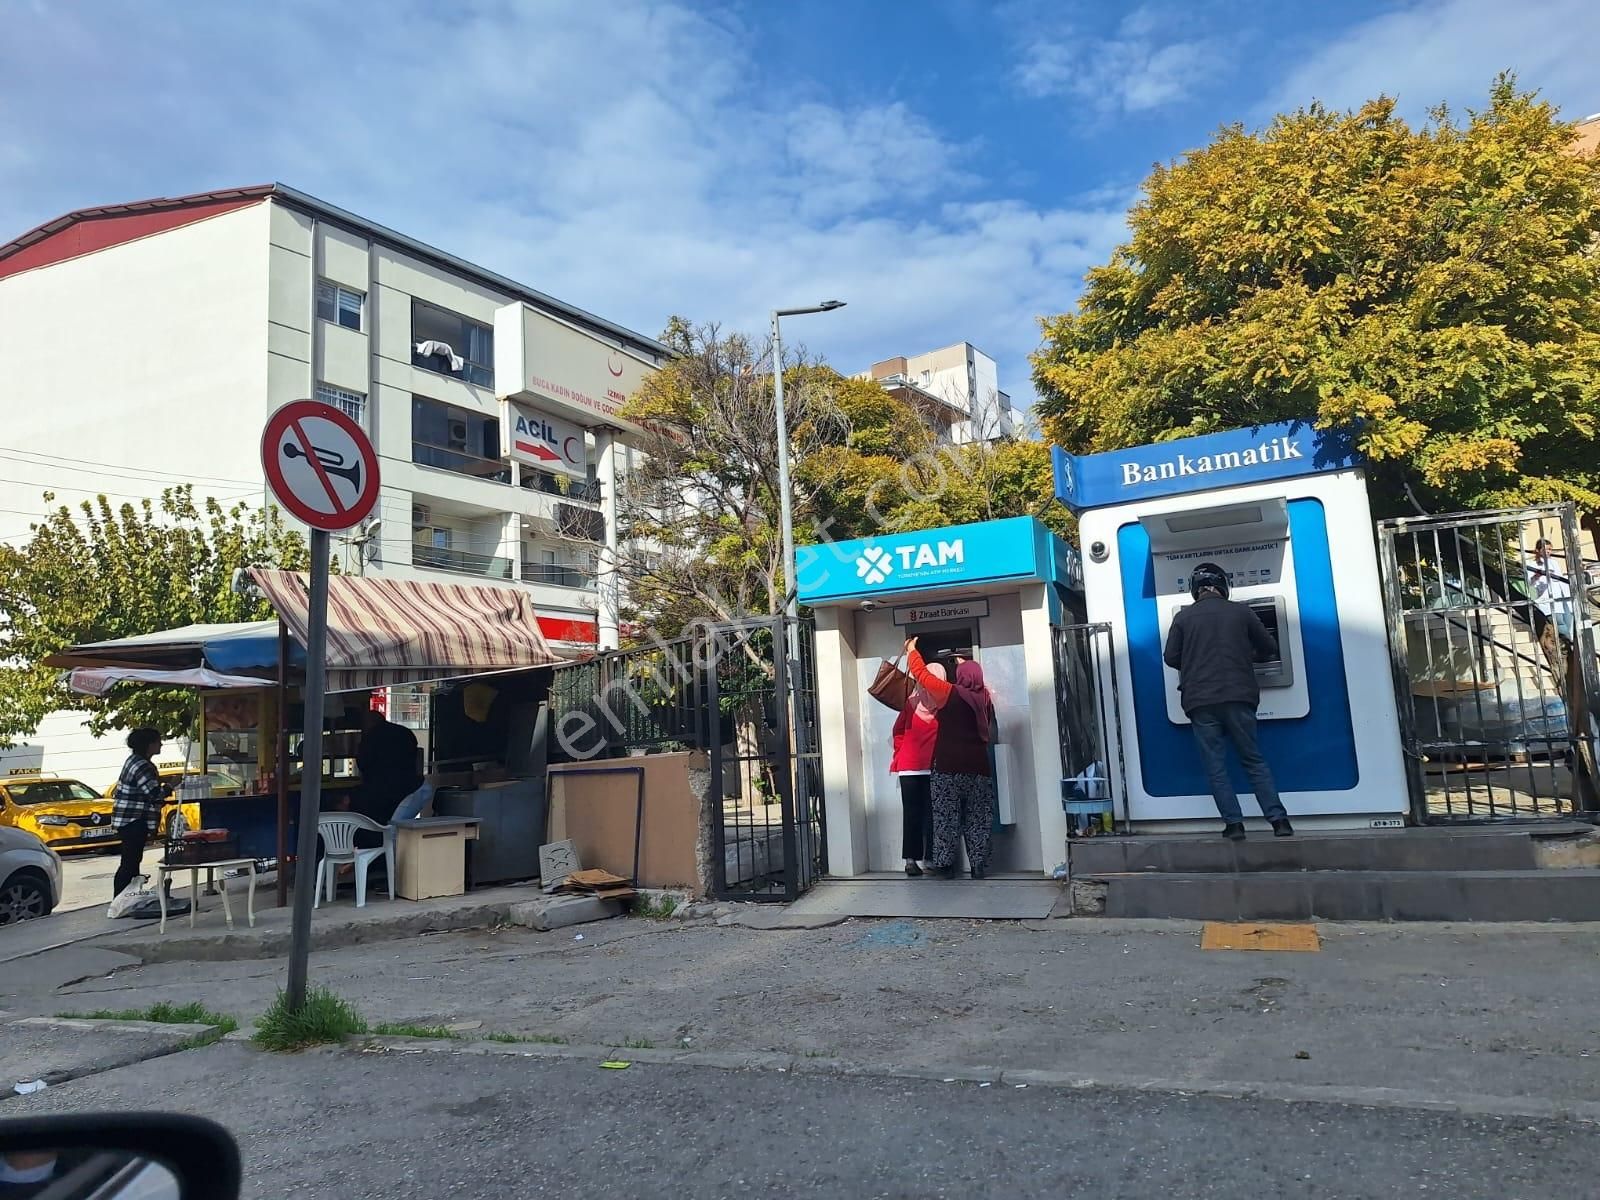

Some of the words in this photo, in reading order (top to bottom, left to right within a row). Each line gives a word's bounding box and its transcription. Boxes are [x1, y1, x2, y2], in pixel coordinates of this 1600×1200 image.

[532, 376, 549, 390] BUCA
[551, 383, 570, 398] KADIN
[571, 390, 592, 406] DOĞUM
[593, 400, 601, 411] VE
[515, 415, 558, 446] ACİL
[1120, 437, 1304, 486] Bankamatik
[895, 538, 965, 570] TAM
[919, 609, 940, 619] Ziraat
[941, 607, 969, 618] Bankası
